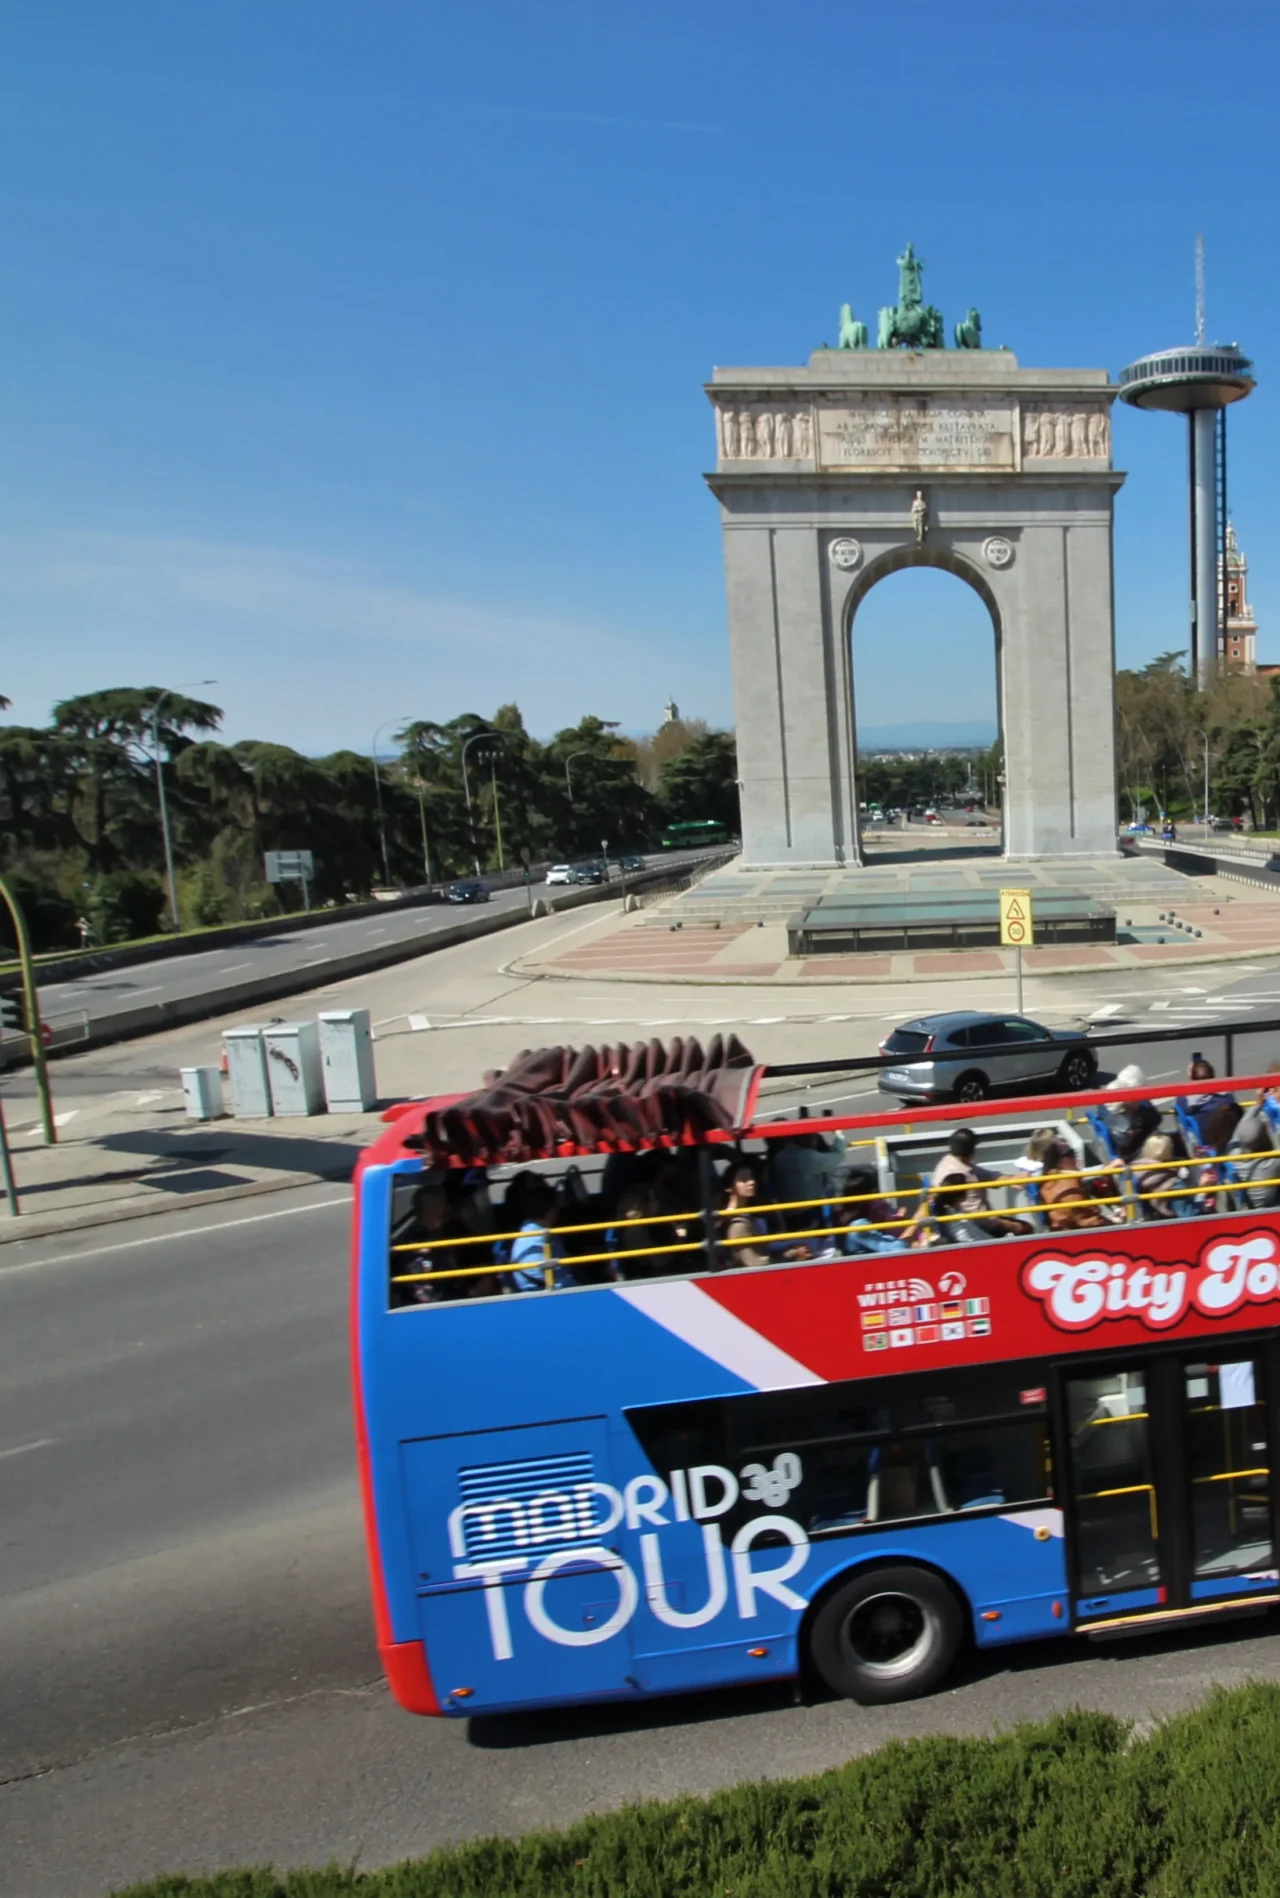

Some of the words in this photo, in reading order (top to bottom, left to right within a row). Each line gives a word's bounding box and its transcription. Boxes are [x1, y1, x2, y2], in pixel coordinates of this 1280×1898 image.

[857, 1289, 909, 1307] WIFI
[864, 1280, 907, 1292] FREE
[1029, 1259, 1186, 1323] City
[453, 1515, 812, 1660] TOUR
